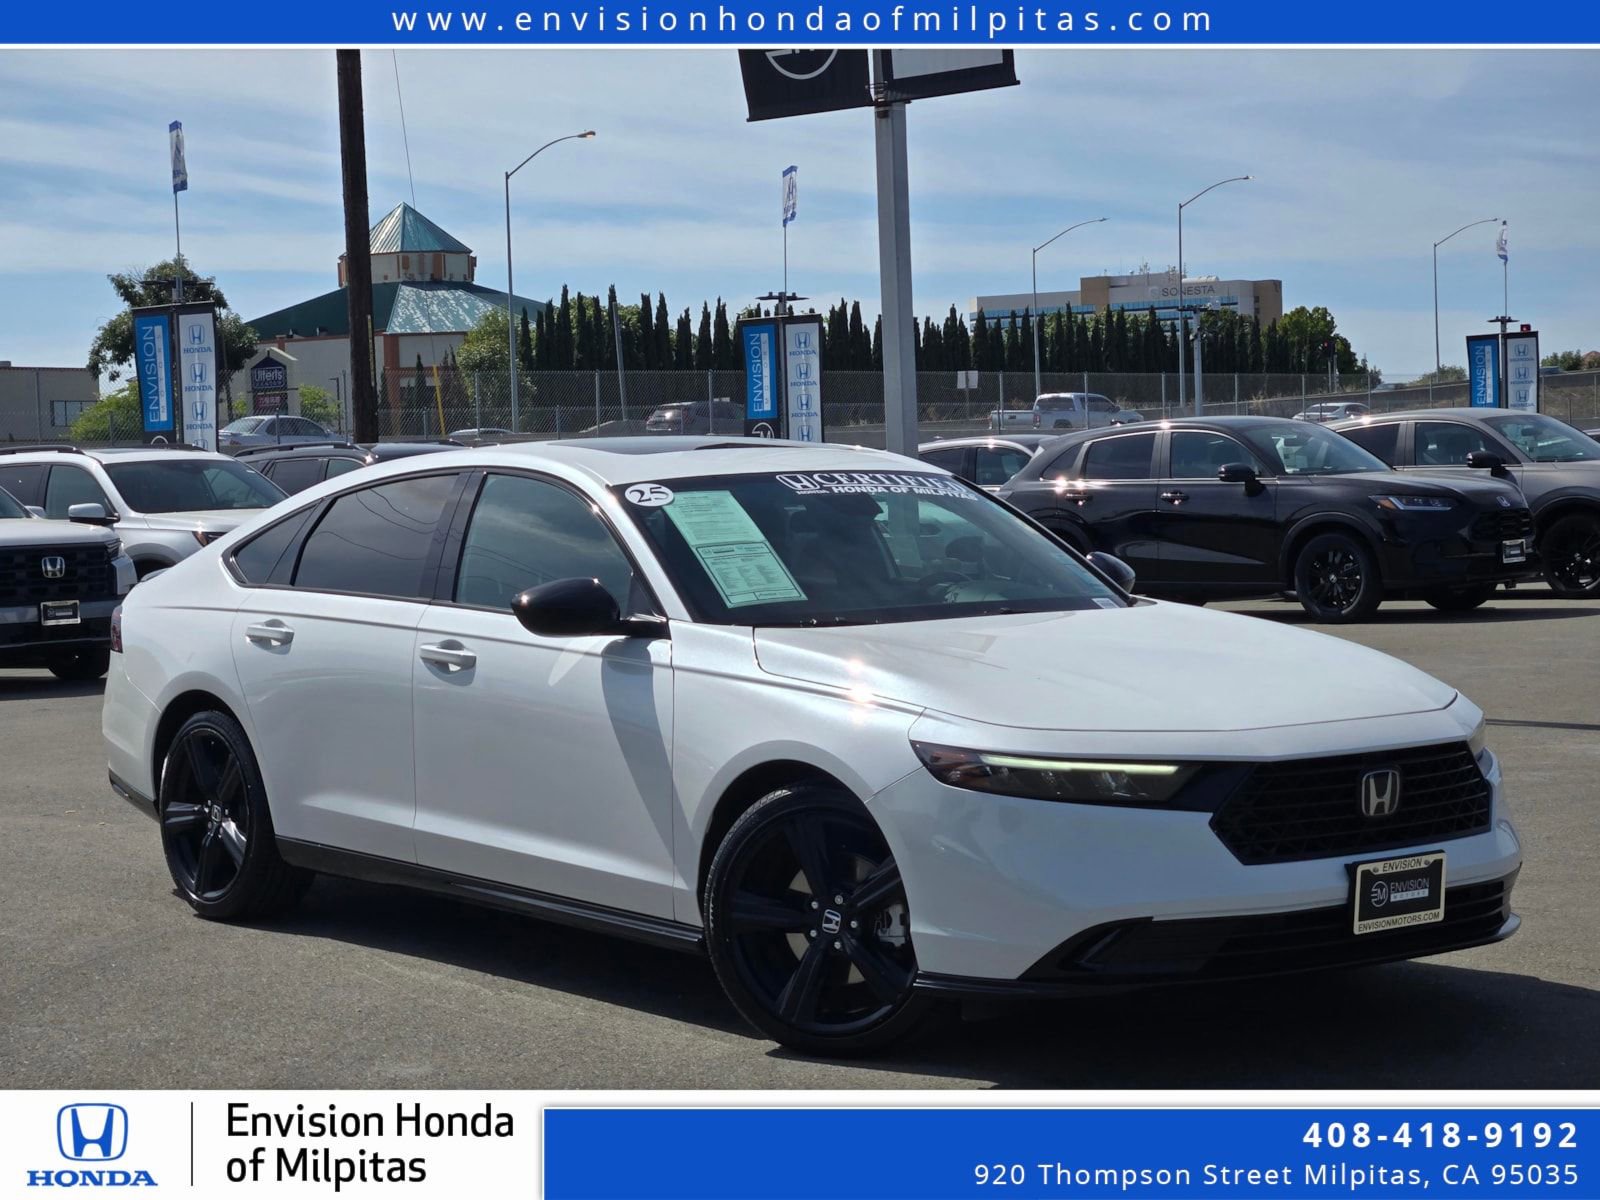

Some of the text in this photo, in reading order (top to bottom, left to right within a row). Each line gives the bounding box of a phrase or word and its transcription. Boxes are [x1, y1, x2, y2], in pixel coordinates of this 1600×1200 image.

[1161, 285, 1215, 297] SONESTA
[183, 346, 212, 354] HONDA
[789, 349, 816, 357] HONDA
[142, 326, 160, 423] ENVISION
[750, 333, 764, 412] ENVISION
[1475, 345, 1486, 405] ENVISION
[185, 385, 213, 393] HONDA
[812, 472, 966, 493] CERTIFIED
[629, 485, 669, 504] 25
[831, 485, 978, 501] HONDA OF MILPITAS
[1382, 858, 1423, 872] ENVISION
[1390, 877, 1430, 893] ENVISION
[1358, 911, 1440, 933] ENVISIONMOTORS.COM
